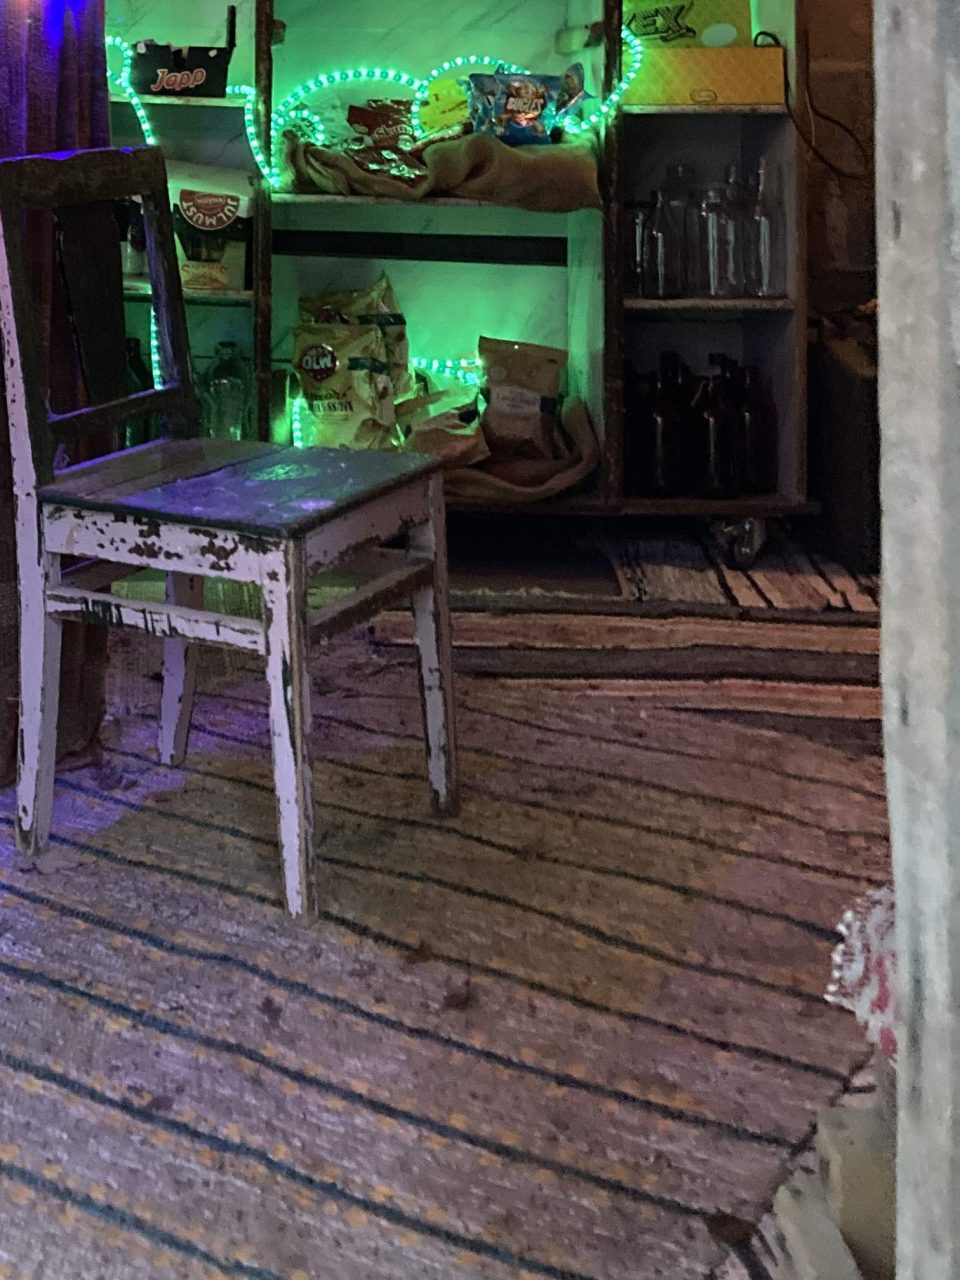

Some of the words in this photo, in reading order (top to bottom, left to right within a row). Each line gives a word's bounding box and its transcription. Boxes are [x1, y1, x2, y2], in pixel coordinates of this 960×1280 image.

[150, 68, 206, 91] Japp
[182, 198, 238, 226] JULMUST
[302, 354, 333, 369] OLW
